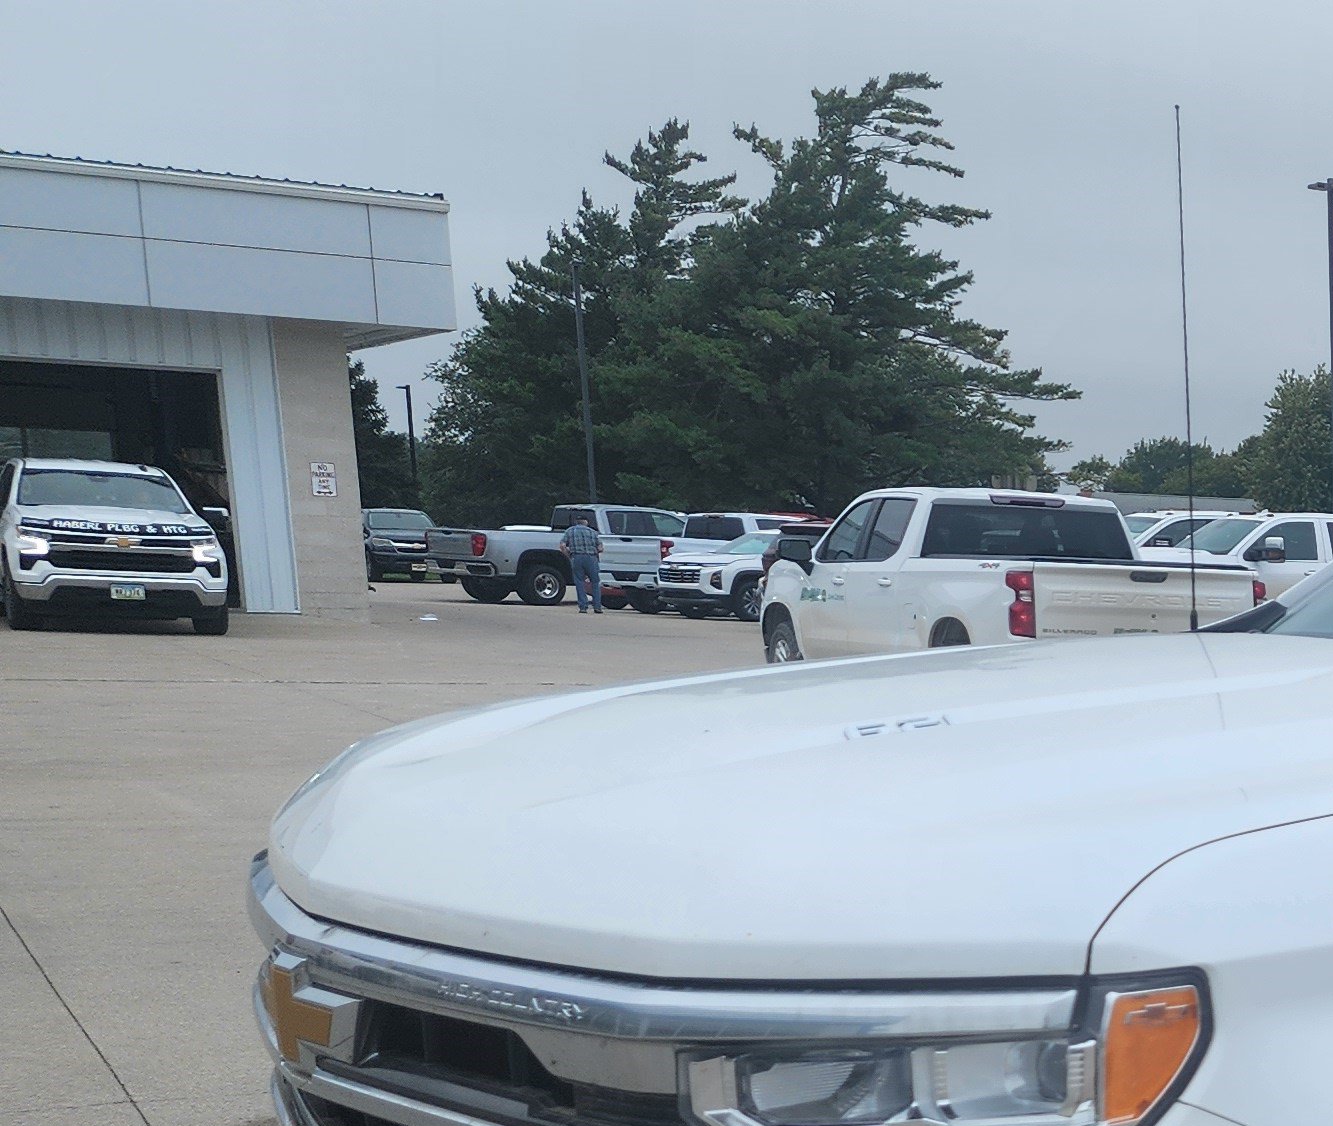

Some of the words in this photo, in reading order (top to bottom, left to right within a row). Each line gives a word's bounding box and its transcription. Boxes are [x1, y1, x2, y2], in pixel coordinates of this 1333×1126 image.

[52, 519, 103, 531] HABERL
[106, 522, 140, 533] PLBG
[145, 525, 158, 534] &
[163, 525, 188, 534] HTG
